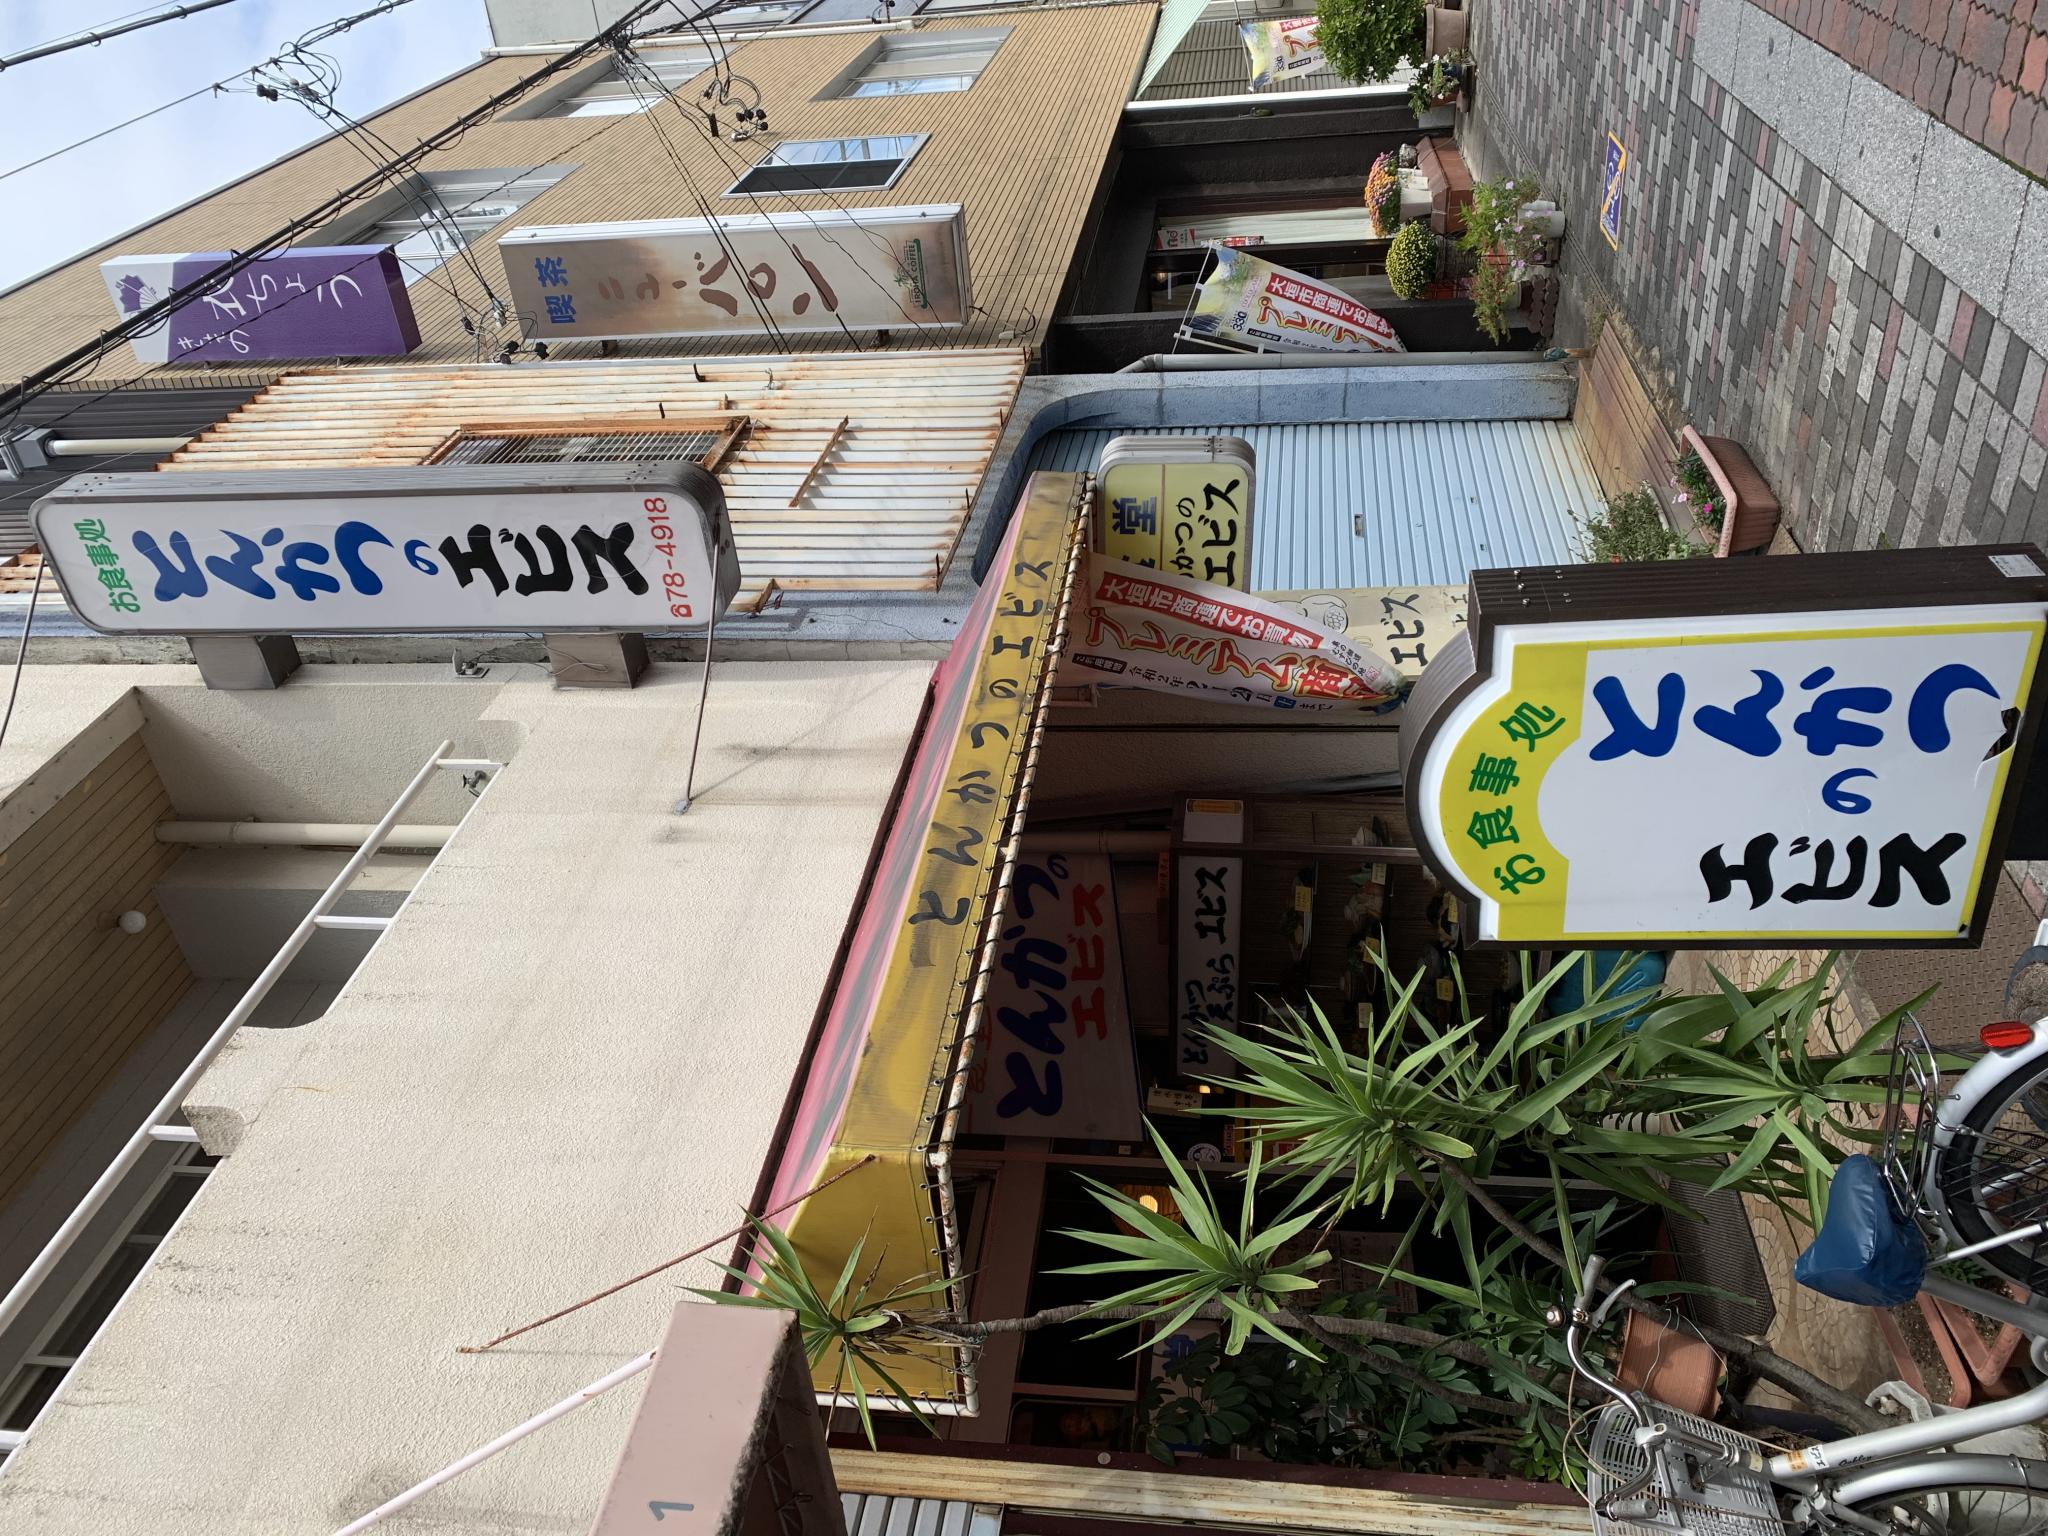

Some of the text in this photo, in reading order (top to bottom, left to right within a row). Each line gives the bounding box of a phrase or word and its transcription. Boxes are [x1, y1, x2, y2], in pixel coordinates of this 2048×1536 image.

[534, 255, 577, 324] 喫茶
[597, 243, 839, 317] ニューバロン
[908, 244, 918, 272] COFFEE
[73, 518, 142, 614] お食事処
[131, 521, 651, 602] とんかつのエビス
[643, 496, 690, 602] 78-4918
[1168, 496, 1196, 579] かつの
[1197, 478, 1241, 587] エビス
[1380, 593, 1429, 667] エビス
[907, 559, 1053, 927] とんかつのエビス
[1588, 663, 2001, 762] とんかつ
[1466, 701, 1566, 896] お食事処
[1193, 866, 1228, 944] エビス
[1698, 831, 1968, 911] エビス
[996, 853, 1069, 1119] とんかつの
[1067, 883, 1108, 1041] エビス
[1206, 953, 1235, 1023] 天ぷら
